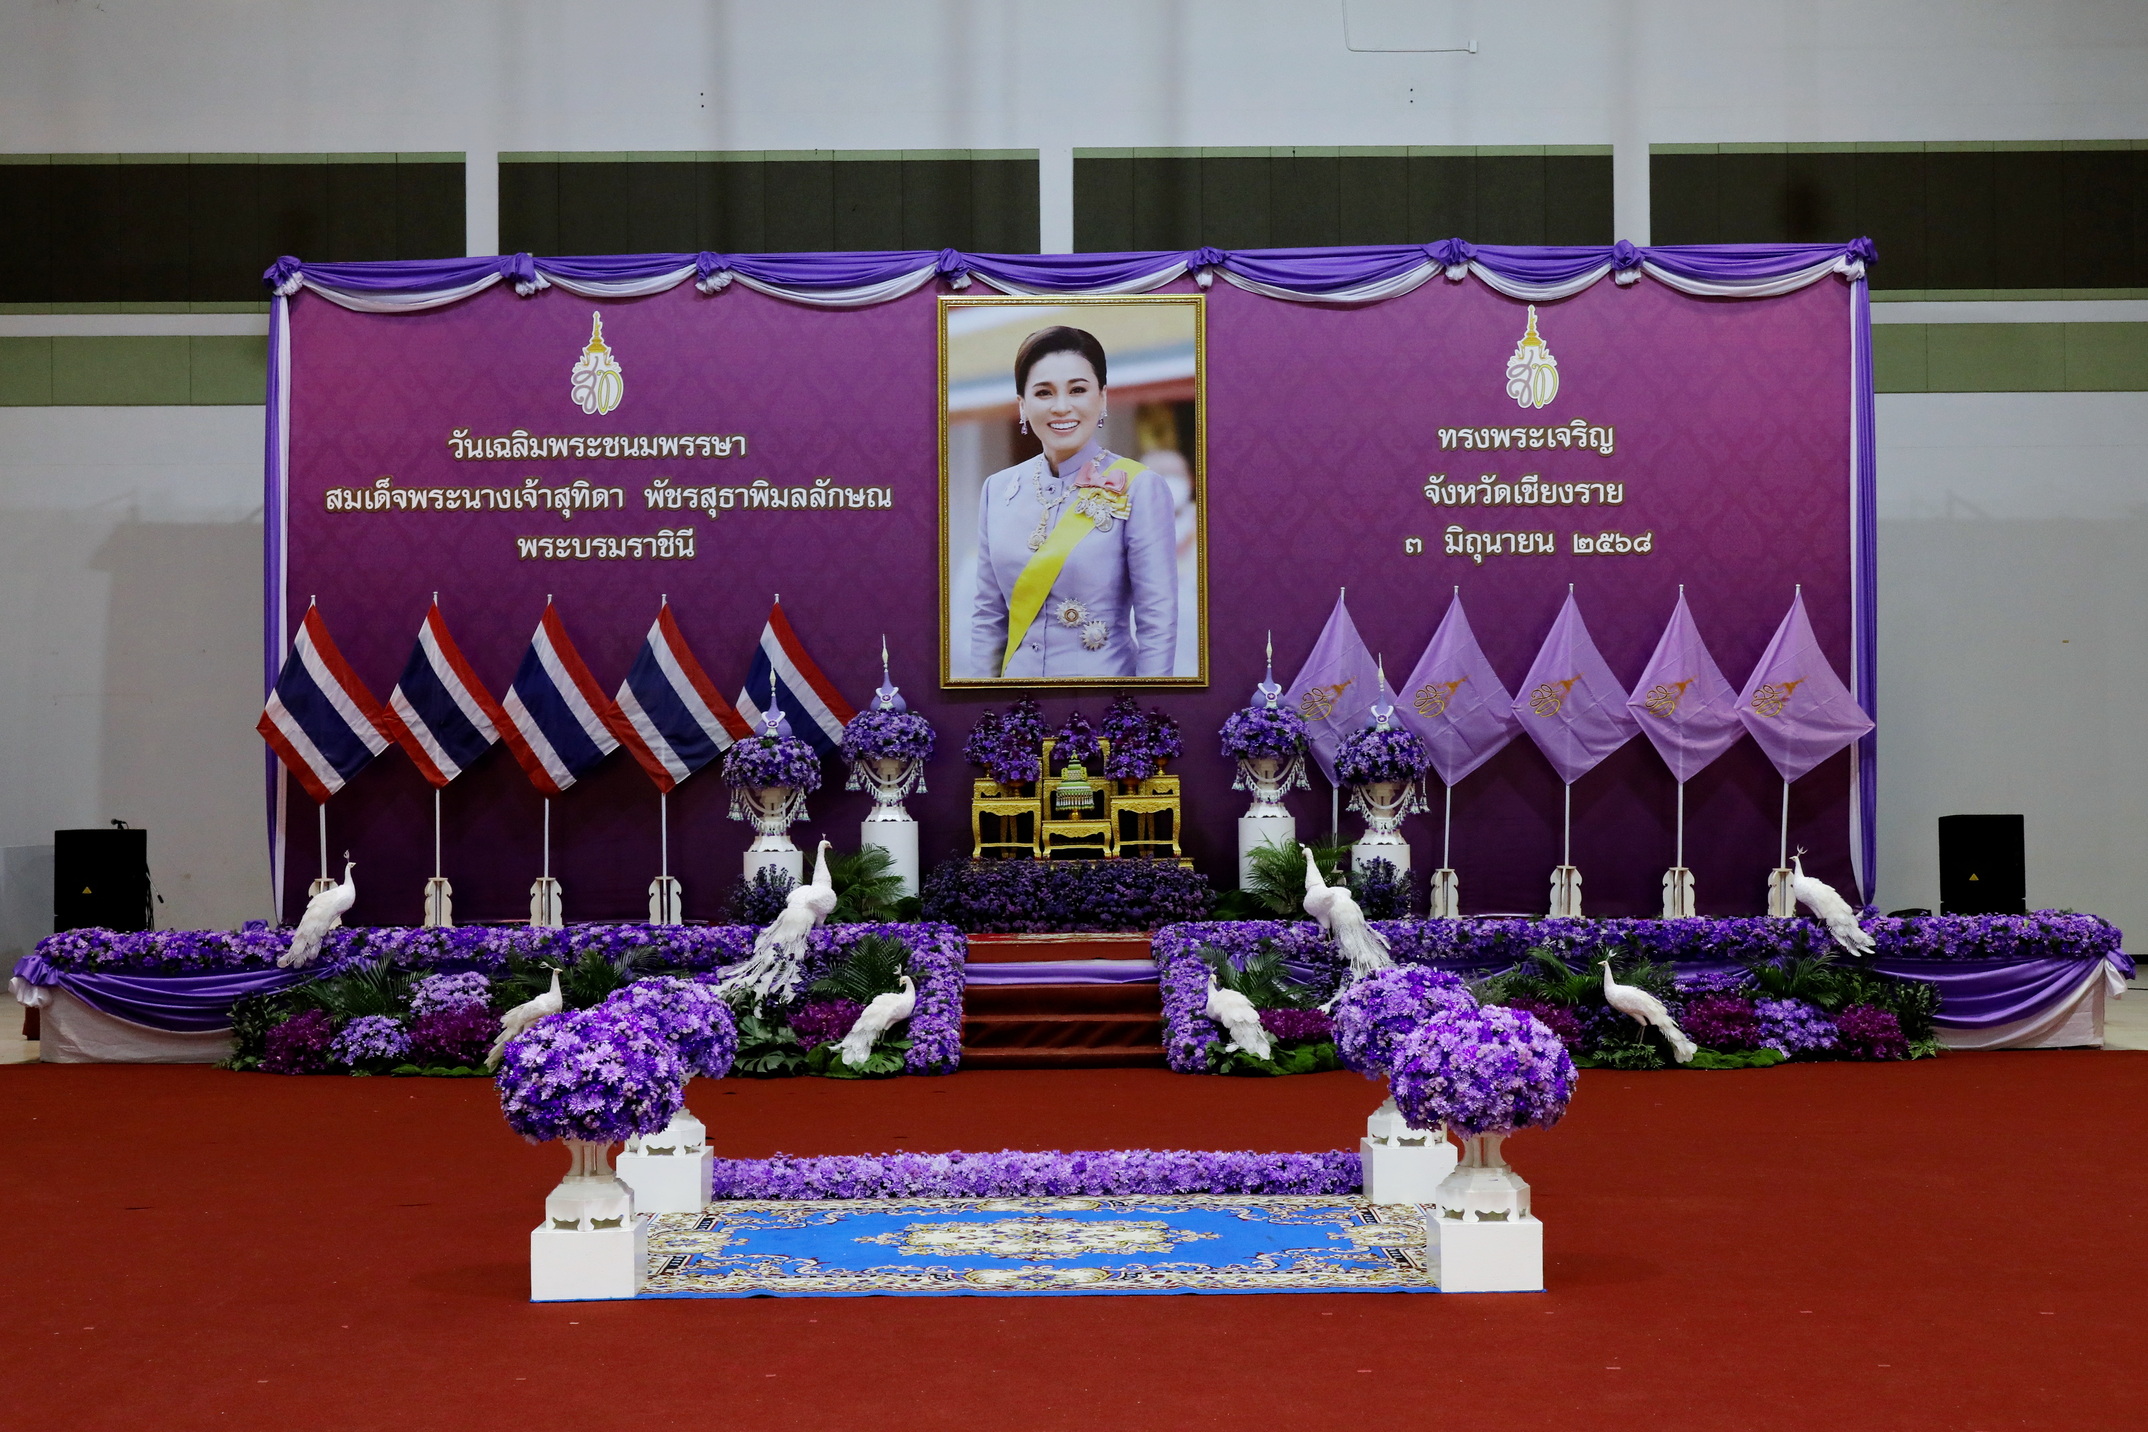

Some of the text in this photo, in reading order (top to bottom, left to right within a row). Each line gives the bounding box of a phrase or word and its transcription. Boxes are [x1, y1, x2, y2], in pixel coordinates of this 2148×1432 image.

[448, 427, 746, 459] วันเฉลิมพระชนมพรรษา
[1438, 419, 1614, 454] ทรงพระเจริญ
[326, 476, 892, 519] สมเด็จพระนางเจ้าสุทิดา พัชรสุธาพิมลลักษณ
[1424, 474, 1623, 505] จังหวัดเชียงราย
[517, 527, 695, 558] พระบรมราชินี
[1405, 525, 1653, 564] ๓ มิถุนายน ๒๕๖๘
